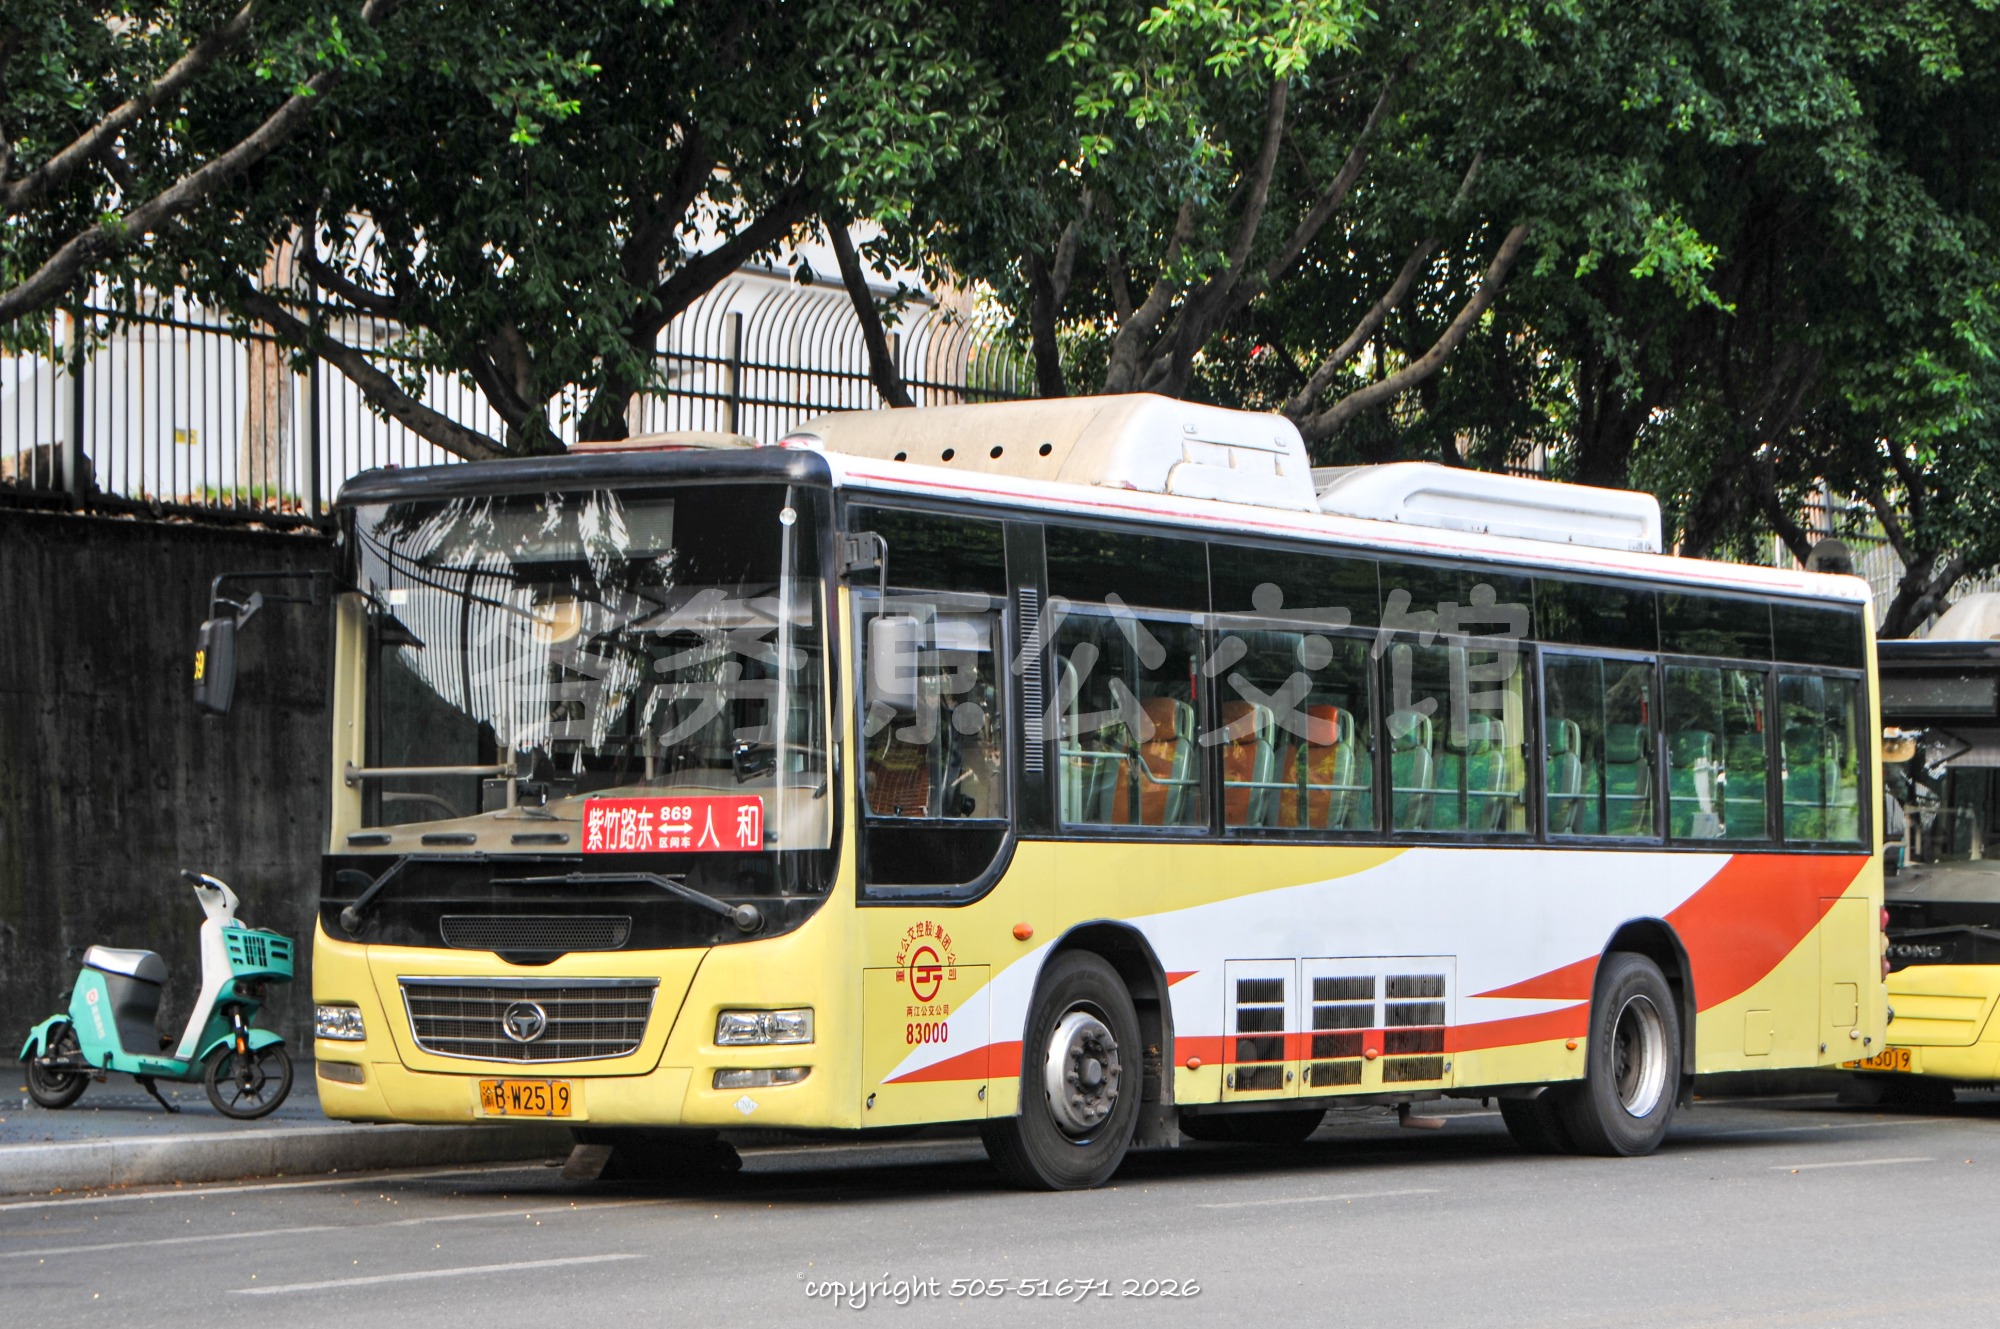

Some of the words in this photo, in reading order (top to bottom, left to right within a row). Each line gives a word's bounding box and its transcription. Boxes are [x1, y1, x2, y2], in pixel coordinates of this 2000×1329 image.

[660, 806, 692, 821] 869
[587, 805, 654, 850] 紫竹路东
[658, 836, 691, 848] 区间车
[906, 1004, 950, 1018] 两江公交公司
[906, 1021, 949, 1045] 83000
